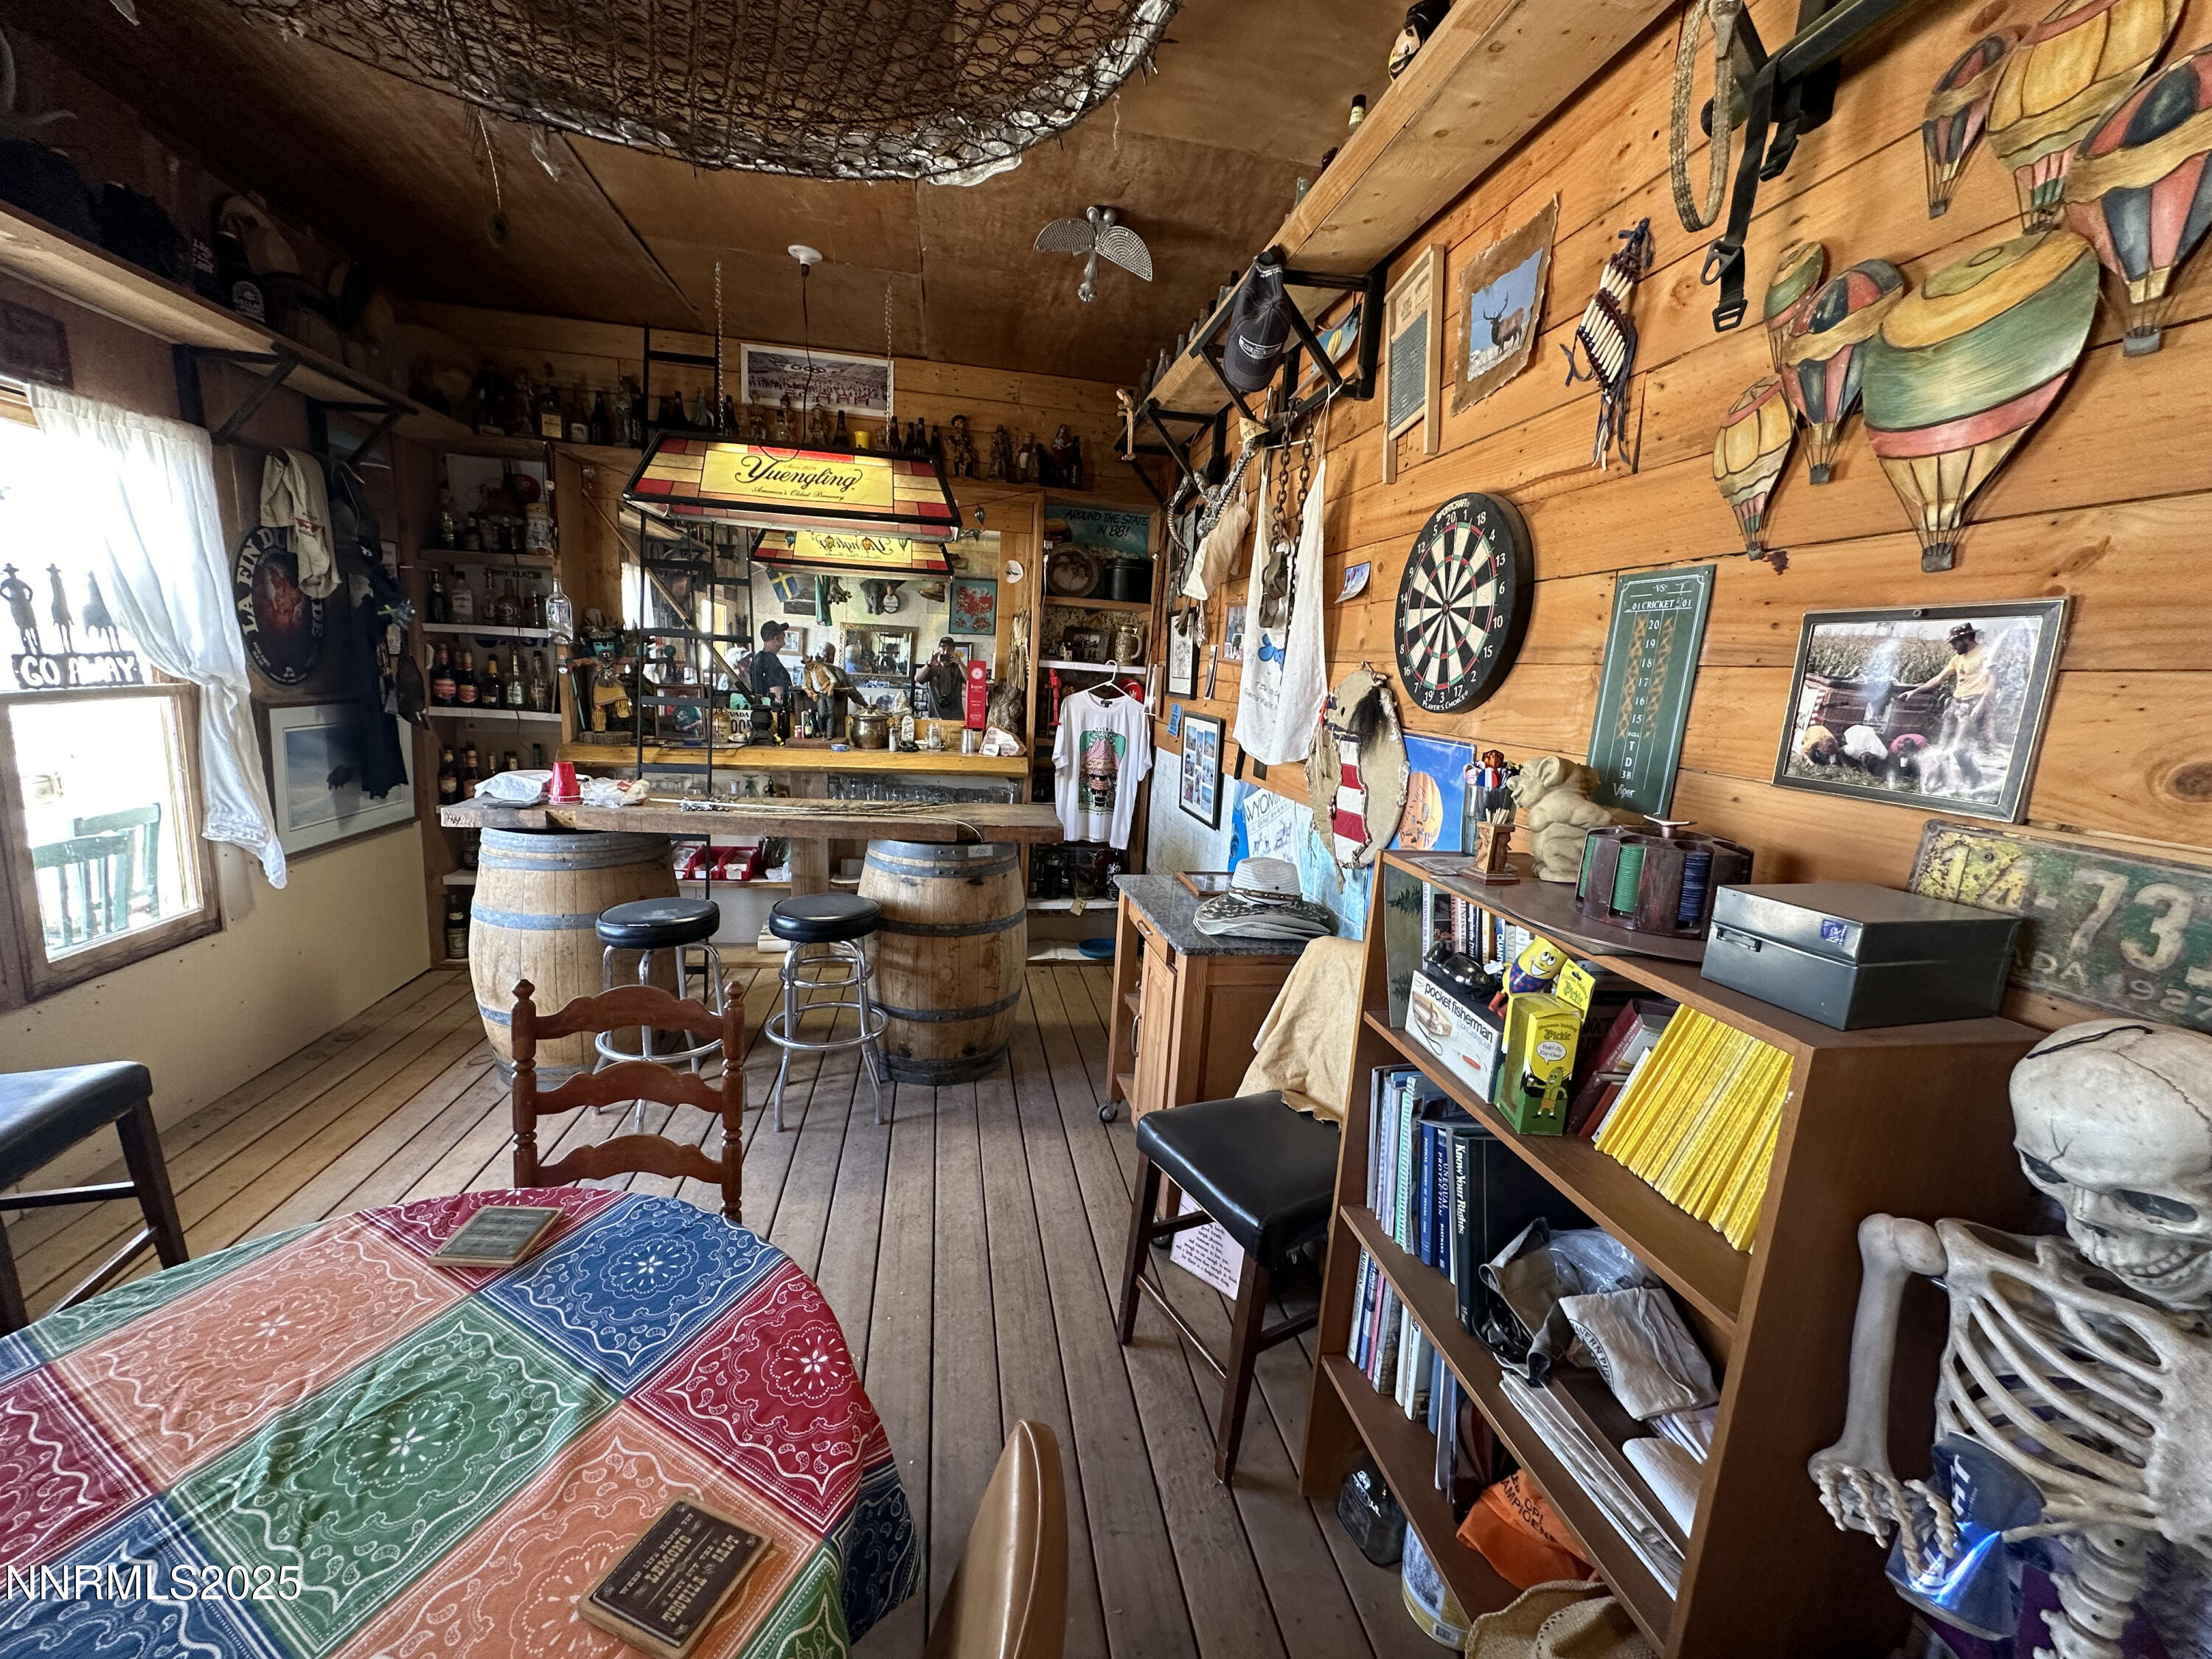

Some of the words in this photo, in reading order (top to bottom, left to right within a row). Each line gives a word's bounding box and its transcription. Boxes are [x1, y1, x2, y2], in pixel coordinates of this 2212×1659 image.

[734, 455, 863, 493] Yuengling
[751, 486, 787, 495] America's
[790, 490, 810, 498] Oldest
[813, 491, 844, 501] Brewery
[1064, 509, 1102, 521] AROUND
[1103, 512, 1119, 524] THE
[1121, 514, 1150, 526] STATE
[1446, 511, 1456, 525] 20
[1464, 509, 1467, 521] 1
[1477, 511, 1486, 526] 18
[1096, 524, 1107, 535] IN
[1433, 526, 1438, 536] 5
[1489, 529, 1496, 540] 4
[1417, 542, 1426, 554] 12
[237, 538, 262, 588] FIN
[1496, 553, 1506, 567] 13
[1409, 567, 1414, 578] 9
[1499, 581, 1505, 594] 6
[1401, 592, 1408, 604] 14
[1642, 599, 1675, 610] CRICKET
[237, 593, 260, 636] LA
[1399, 617, 1405, 628] 11
[1492, 615, 1503, 629] 10
[1649, 620, 1659, 630] 20
[1399, 644, 1405, 654] 8
[1646, 639, 1655, 649] 19
[1483, 645, 1493, 658] 15
[1641, 658, 1652, 668] 18
[21, 655, 60, 686] GO
[1404, 666, 1411, 676] 16
[1470, 671, 1477, 682] 2
[1413, 683, 1419, 693] 7
[1638, 678, 1649, 687] 17
[1424, 691, 1433, 702] 19
[1439, 692, 1445, 703] 3
[1454, 685, 1464, 698] 17
[1635, 697, 1645, 706] 16
[1632, 714, 1642, 724] 15
[1630, 741, 1635, 751] T
[1625, 757, 1632, 767] D
[1613, 782, 1635, 799] Viper
[1425, 983, 1452, 1010] pocket
[1451, 1001, 1493, 1043] fisherman
[1544, 1029, 1571, 1040] Pickle
[1455, 1143, 1466, 1175] Know
[1455, 1172, 1467, 1199] Your
[1457, 1199, 1467, 1235] Rights
[619, 1571, 642, 1594] WHEN
[643, 1552, 660, 1570] LIFE
[681, 1513, 694, 1526] YOU
[699, 1545, 714, 1560] THE
[644, 1534, 692, 1584] LEMONS
[661, 1576, 708, 1623] TEQUILA
[712, 1534, 739, 1563] SALT
